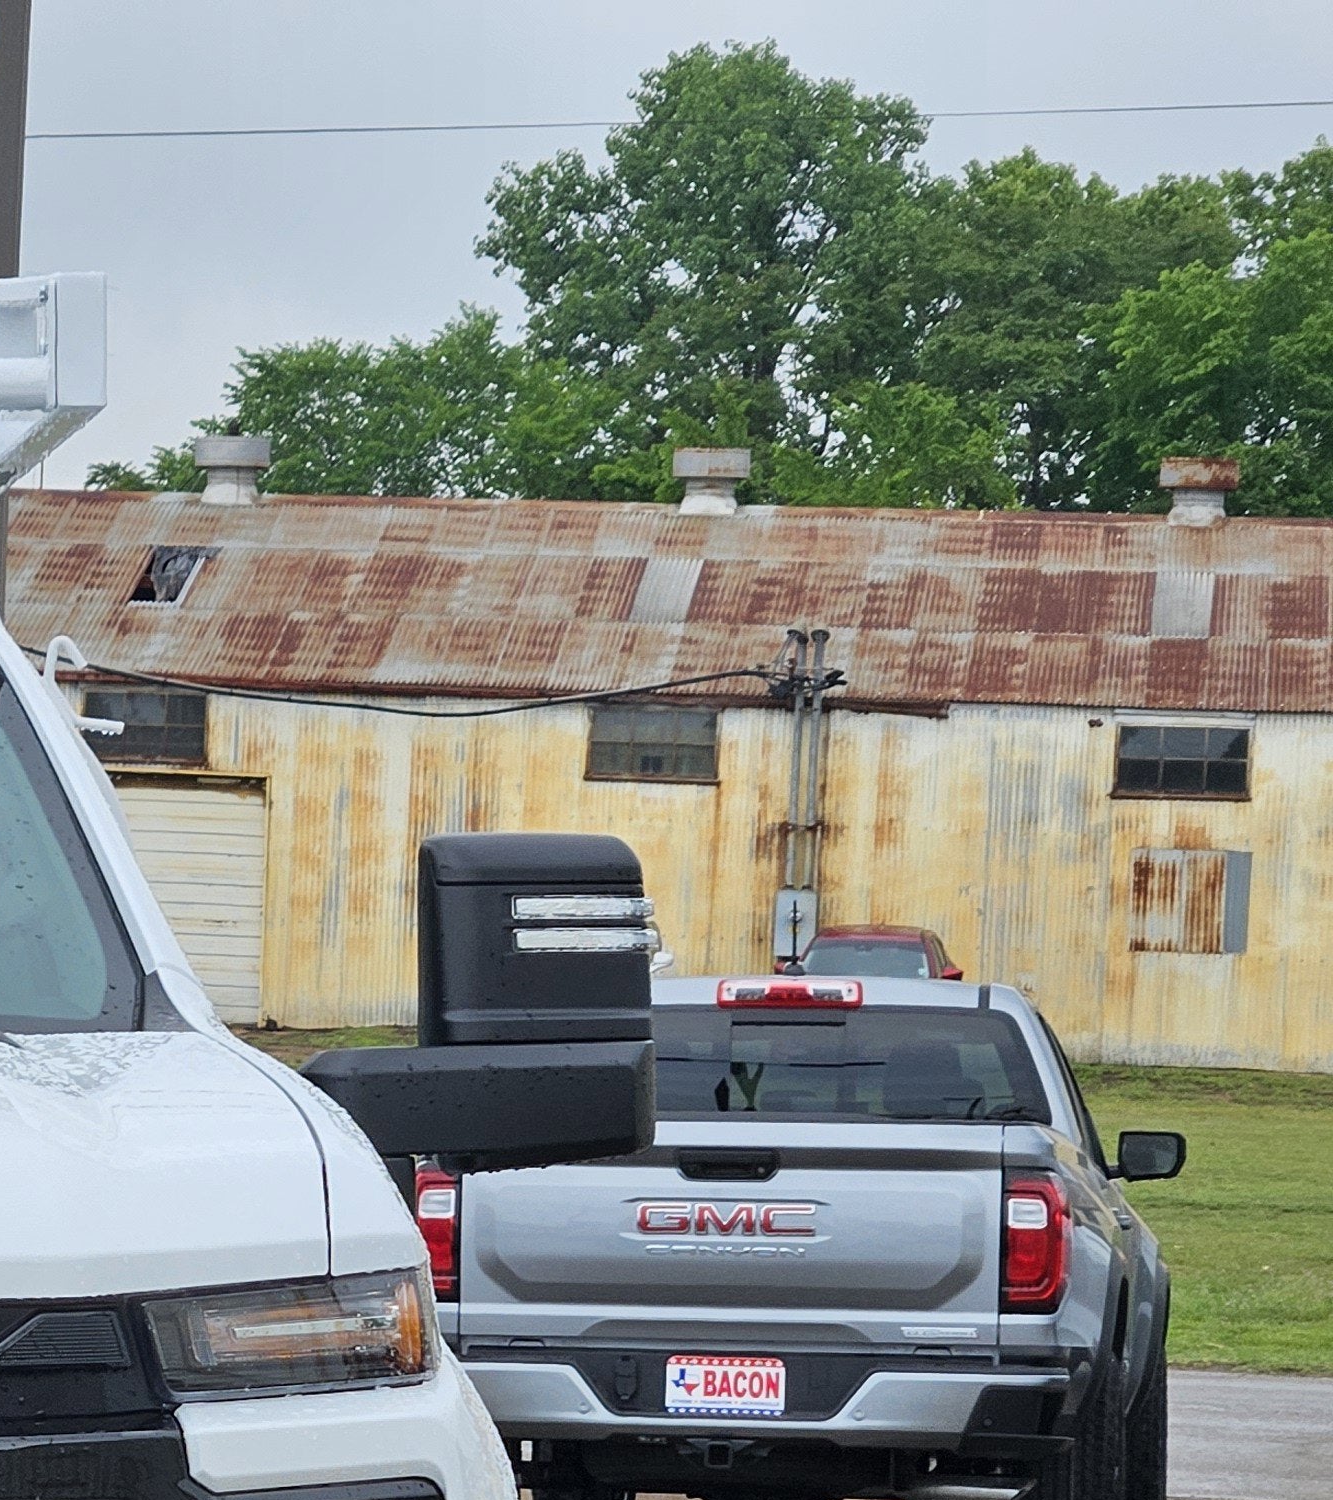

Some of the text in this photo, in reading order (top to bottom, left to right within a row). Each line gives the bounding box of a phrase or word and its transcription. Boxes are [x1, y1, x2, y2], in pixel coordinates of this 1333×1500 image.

[637, 1203, 816, 1237] GMC
[645, 1244, 807, 1258] CANYON
[703, 1369, 781, 1399] BACON
